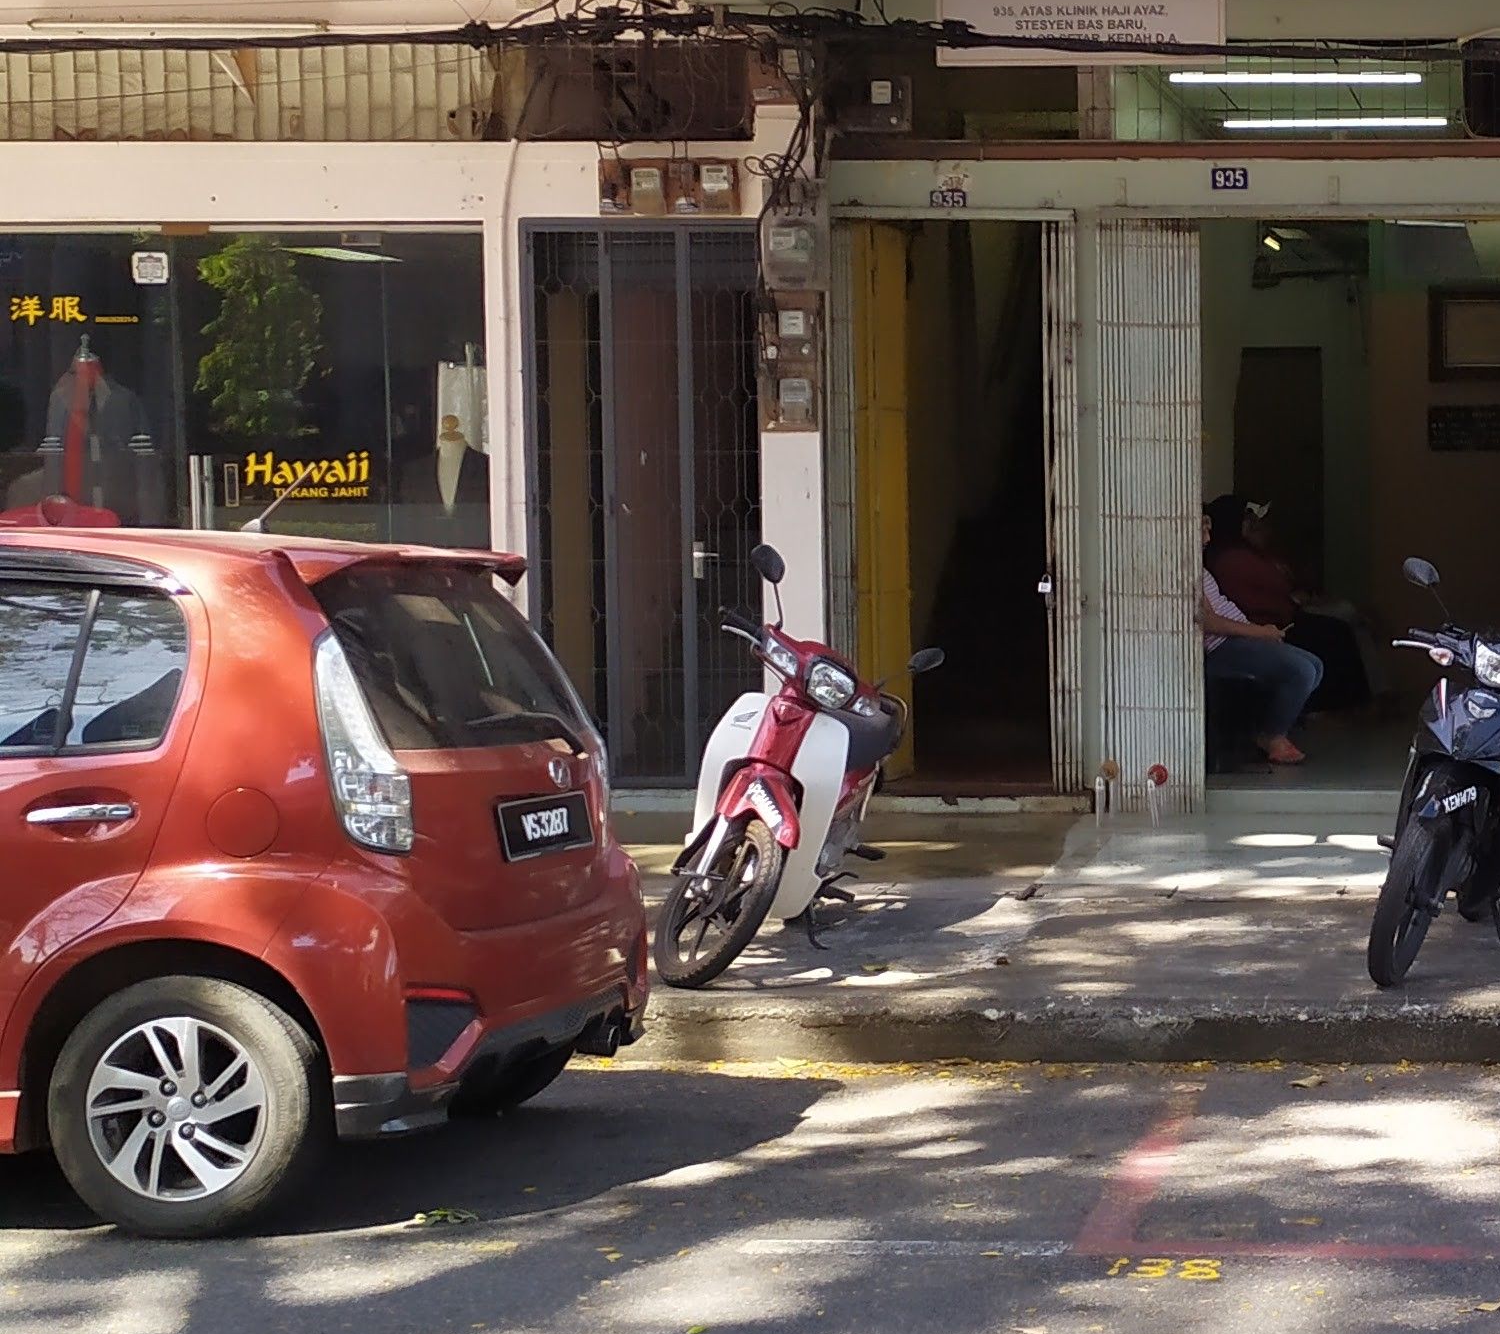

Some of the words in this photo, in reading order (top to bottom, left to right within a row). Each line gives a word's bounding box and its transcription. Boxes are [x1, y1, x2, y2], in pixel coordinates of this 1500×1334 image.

[1021, 6, 1052, 17] ATAS
[1056, 5, 1097, 16] KLINIK
[1102, 5, 1131, 16] HAJI
[1015, 20, 1074, 31] STESYEN
[1077, 20, 1103, 30] BAS
[1108, 20, 1147, 32] BARU,
[1216, 169, 1245, 187] 935
[932, 191, 964, 208] 935
[10, 295, 87, 326] 洋服
[244, 450, 370, 486] Hawaii
[331, 486, 370, 497] JAHIT
